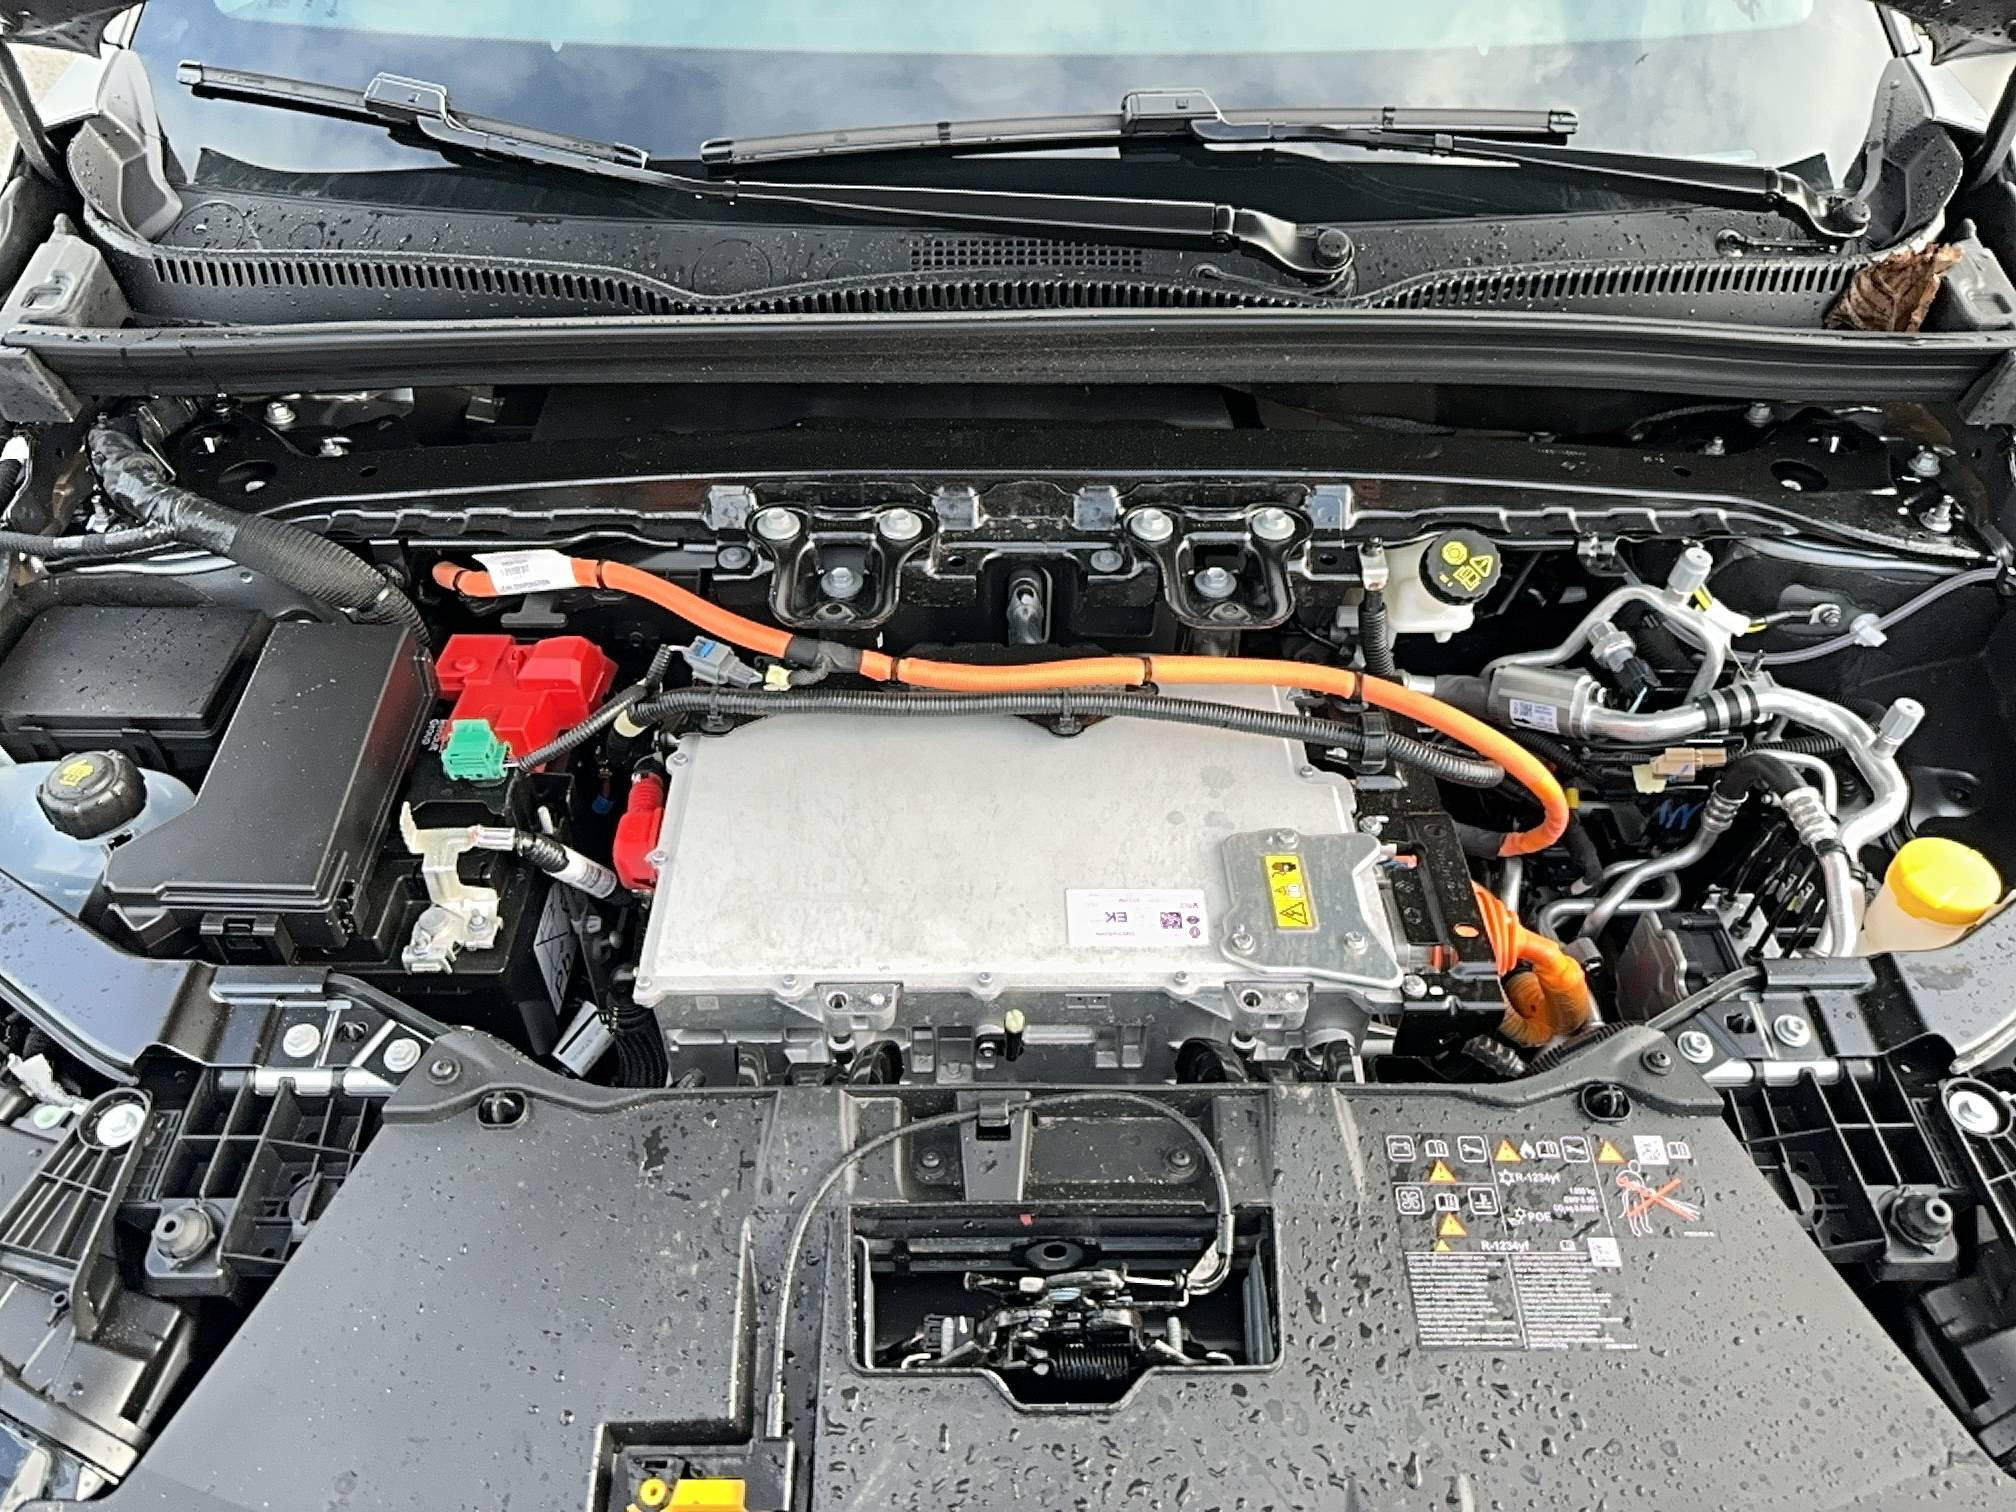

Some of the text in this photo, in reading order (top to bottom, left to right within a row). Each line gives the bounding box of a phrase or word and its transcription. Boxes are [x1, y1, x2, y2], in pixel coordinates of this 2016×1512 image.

[1105, 911, 1128, 923] EK
[1515, 1172, 1561, 1185] R-1234yf
[1527, 1211, 1553, 1222] POE
[1480, 1240, 1530, 1252] R-1234yf
